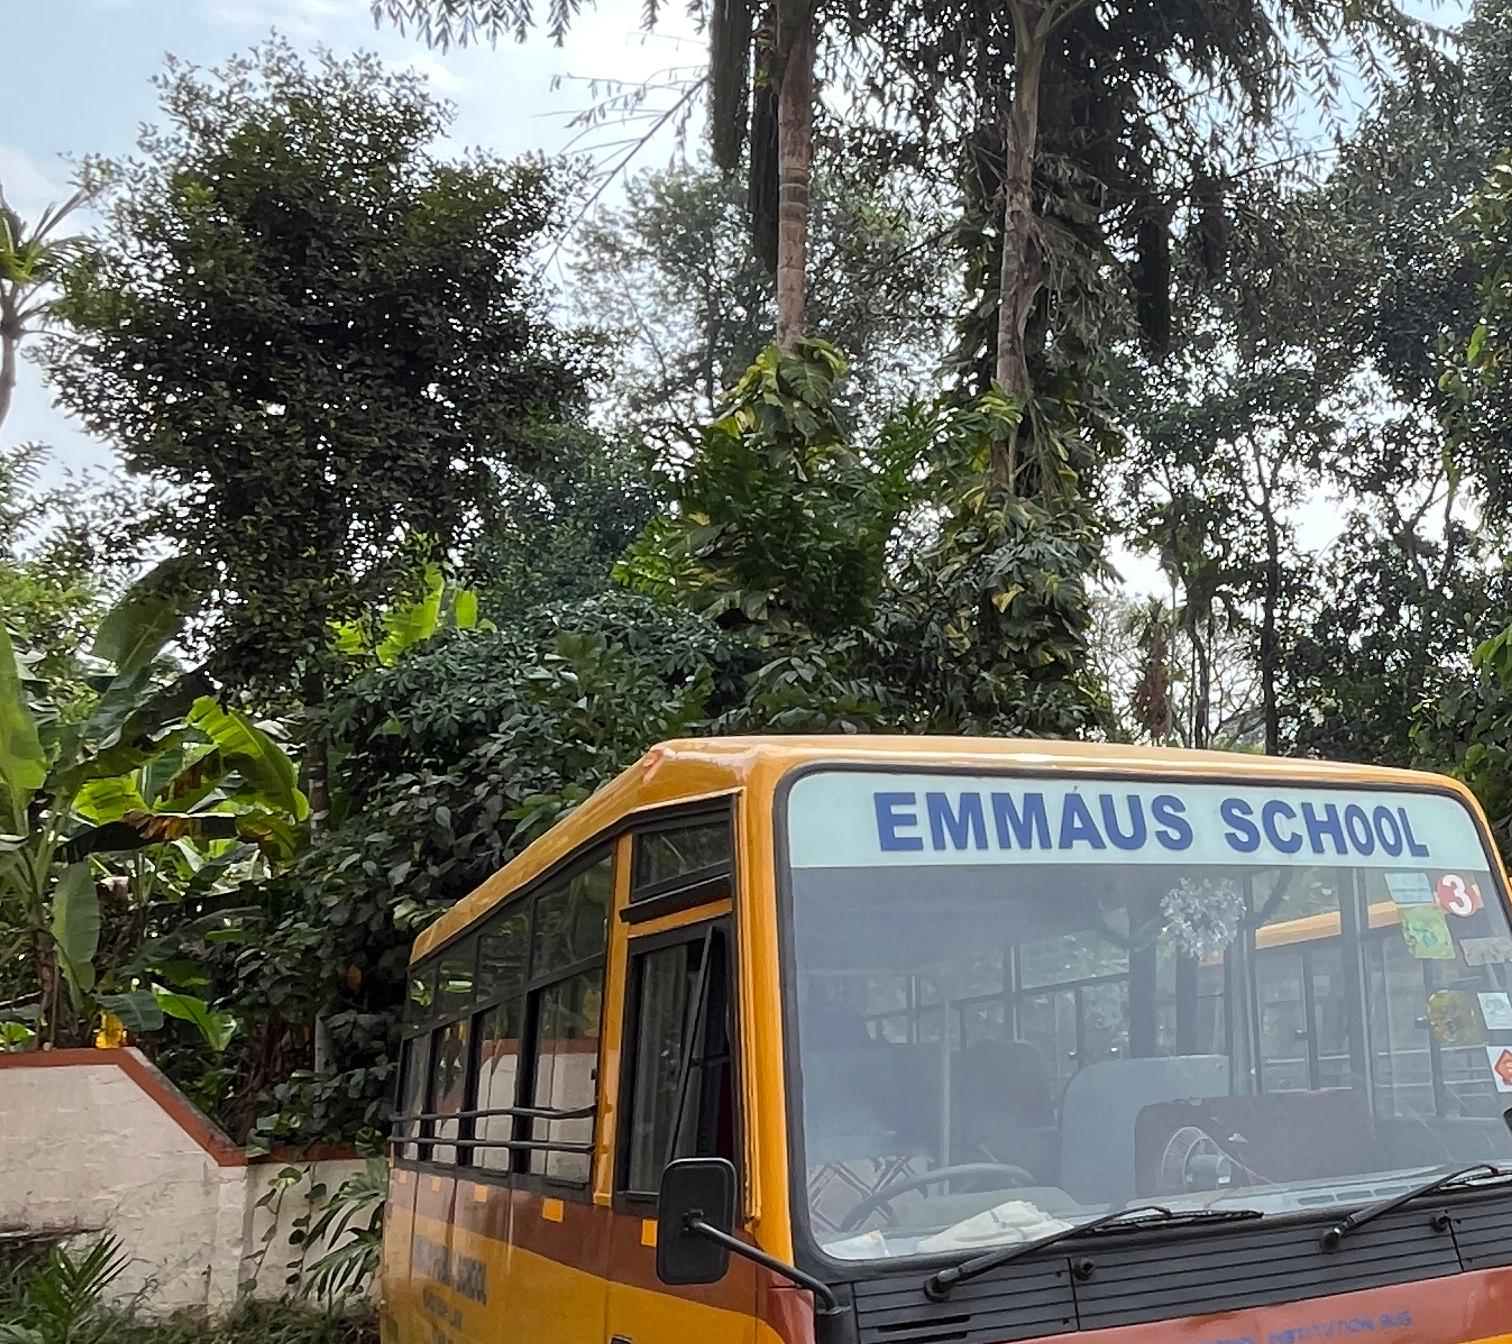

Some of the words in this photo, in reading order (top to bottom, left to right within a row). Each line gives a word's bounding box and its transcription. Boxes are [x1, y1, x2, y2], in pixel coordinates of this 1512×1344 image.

[873, 790, 1194, 852] EMMAUS
[1219, 797, 1430, 858] SCHOOL
[1441, 864, 1473, 916] 3
